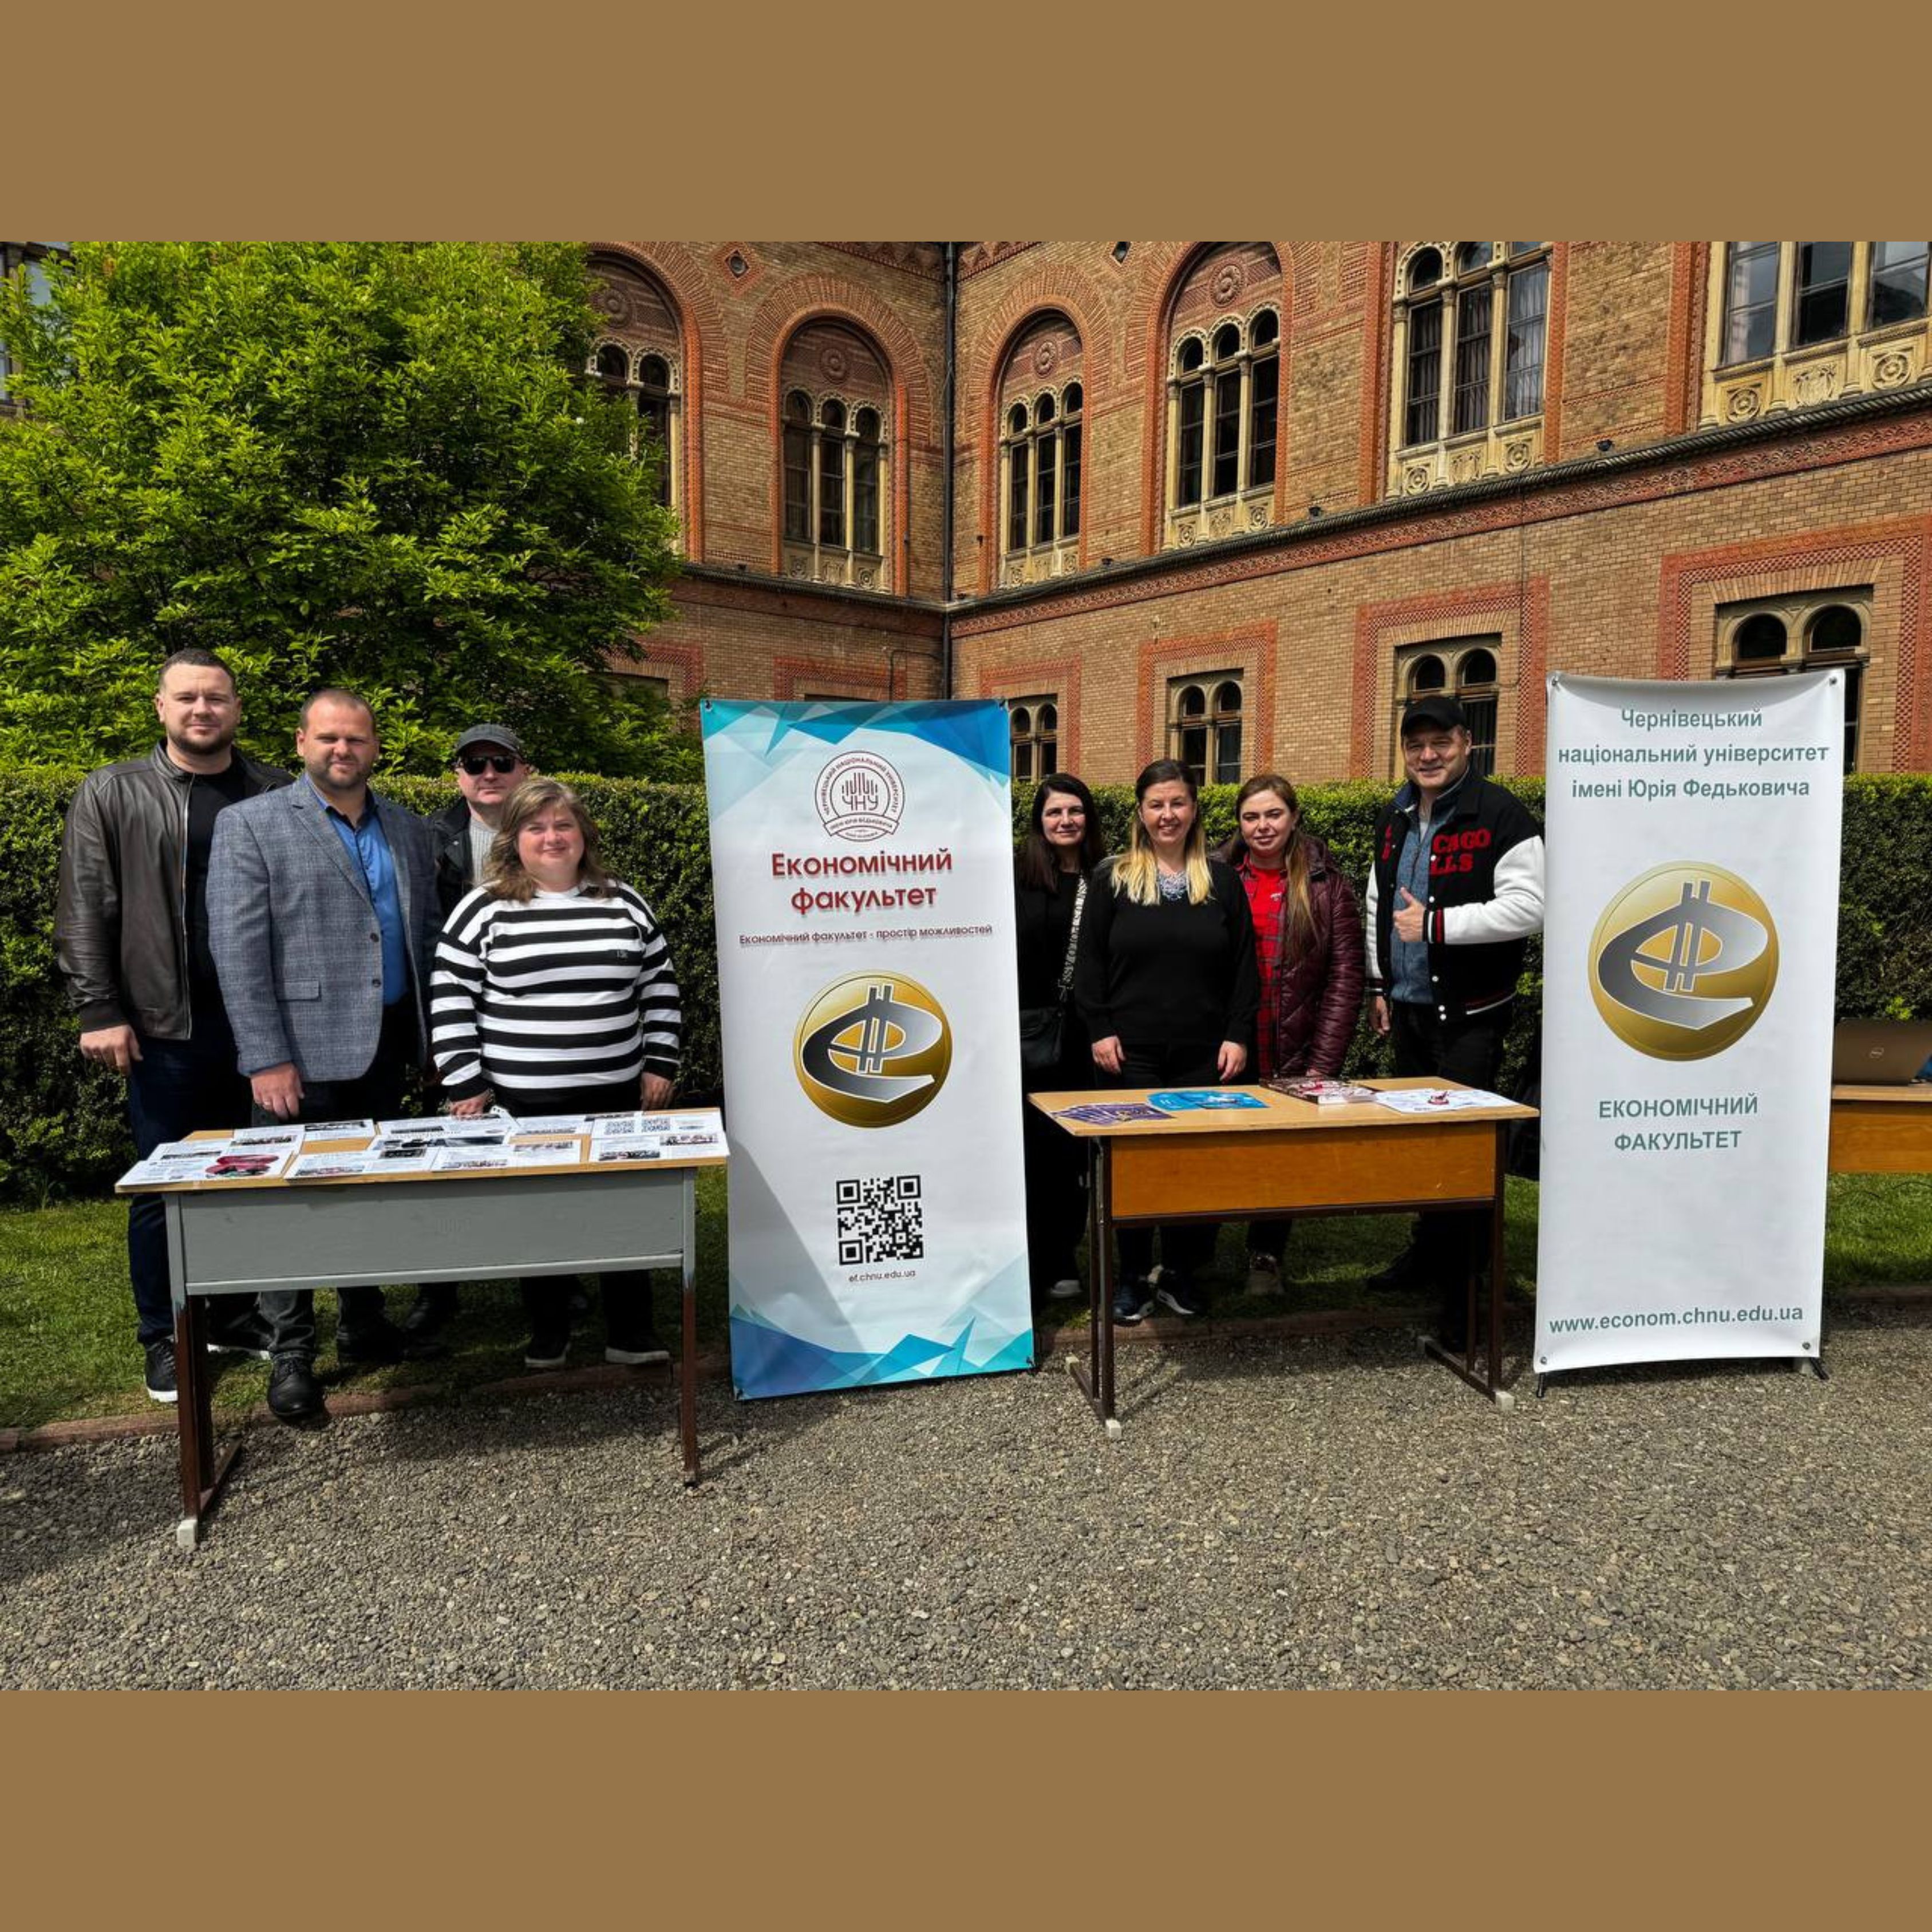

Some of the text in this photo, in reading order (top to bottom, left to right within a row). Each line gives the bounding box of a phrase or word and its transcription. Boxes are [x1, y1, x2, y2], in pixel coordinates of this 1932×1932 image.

[1622, 707, 1761, 731] Чернівецький
[1558, 744, 1829, 766] національний університет
[1572, 779, 1809, 801] імені Юрія Федьковича
[772, 848, 953, 877] Економічний
[791, 887, 937, 914] факультет
[739, 933, 810, 945] Економічний
[812, 931, 867, 943] факультет
[876, 927, 918, 941] простір
[919, 924, 993, 937] можливостей
[1599, 1092, 1758, 1119] ЕКОНОМІЧНИЙ
[1614, 1131, 1742, 1151] ФАКУЛЬТЕТ
[1550, 1305, 1803, 1333] www.econom.chnu.edu.ua
